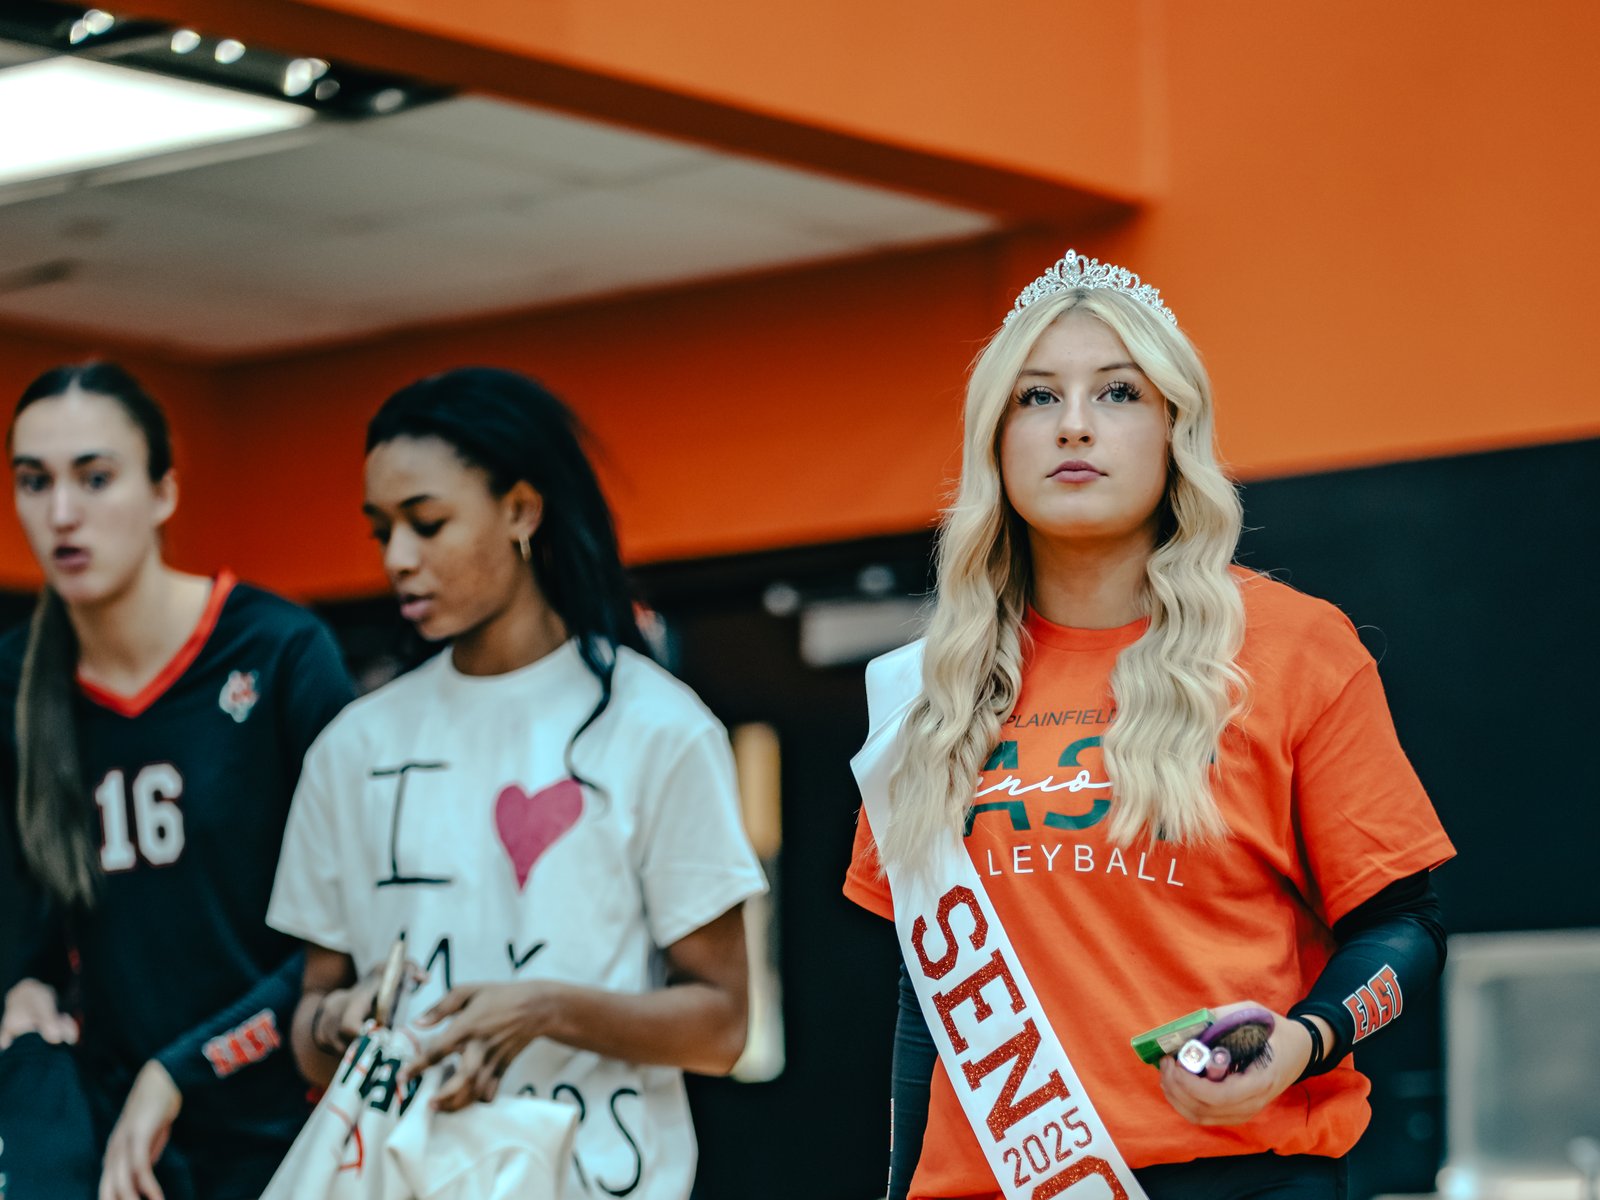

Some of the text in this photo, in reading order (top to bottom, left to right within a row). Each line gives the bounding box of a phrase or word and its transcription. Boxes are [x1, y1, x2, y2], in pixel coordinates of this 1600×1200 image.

[95, 762, 186, 872] 16
[371, 762, 453, 888] I
[979, 842, 1184, 887] LEYBALL
[1342, 963, 1404, 1046] EAST
[1003, 1106, 1093, 1189] 2025
